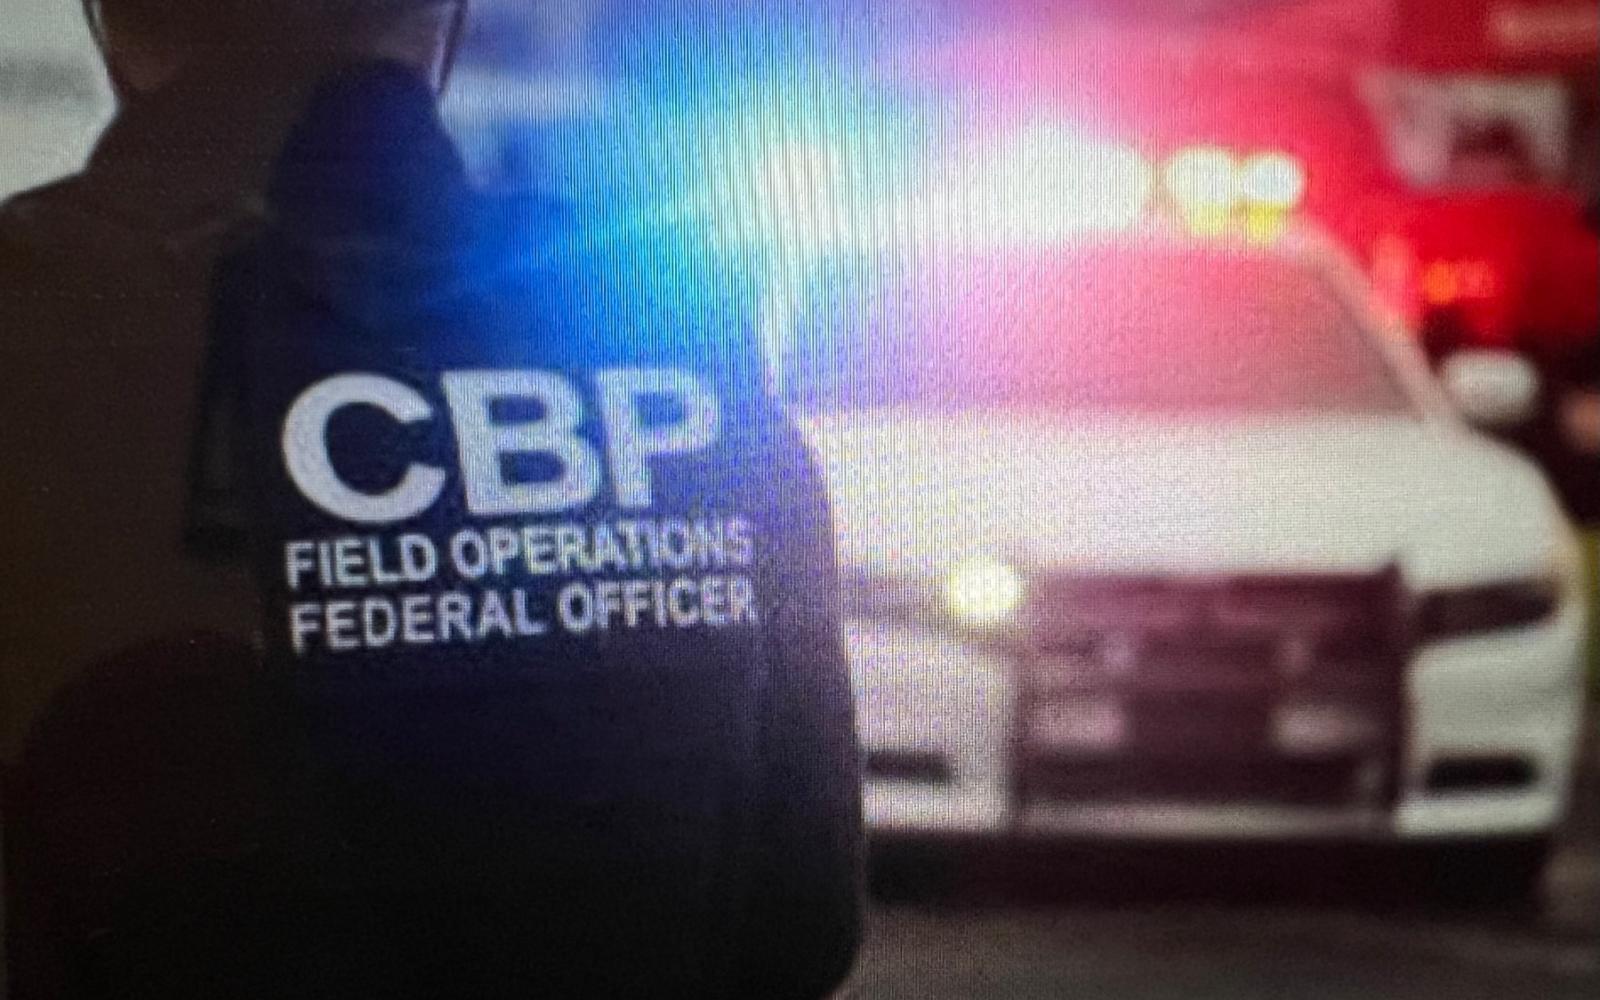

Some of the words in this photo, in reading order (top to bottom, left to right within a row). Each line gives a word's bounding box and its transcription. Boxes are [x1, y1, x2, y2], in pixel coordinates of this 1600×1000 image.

[282, 368, 719, 523] CBP
[285, 533, 438, 590] FIELD
[450, 517, 754, 579] OPERATIONS
[289, 588, 547, 655] FEDERAL
[557, 575, 757, 632] OFFICER
